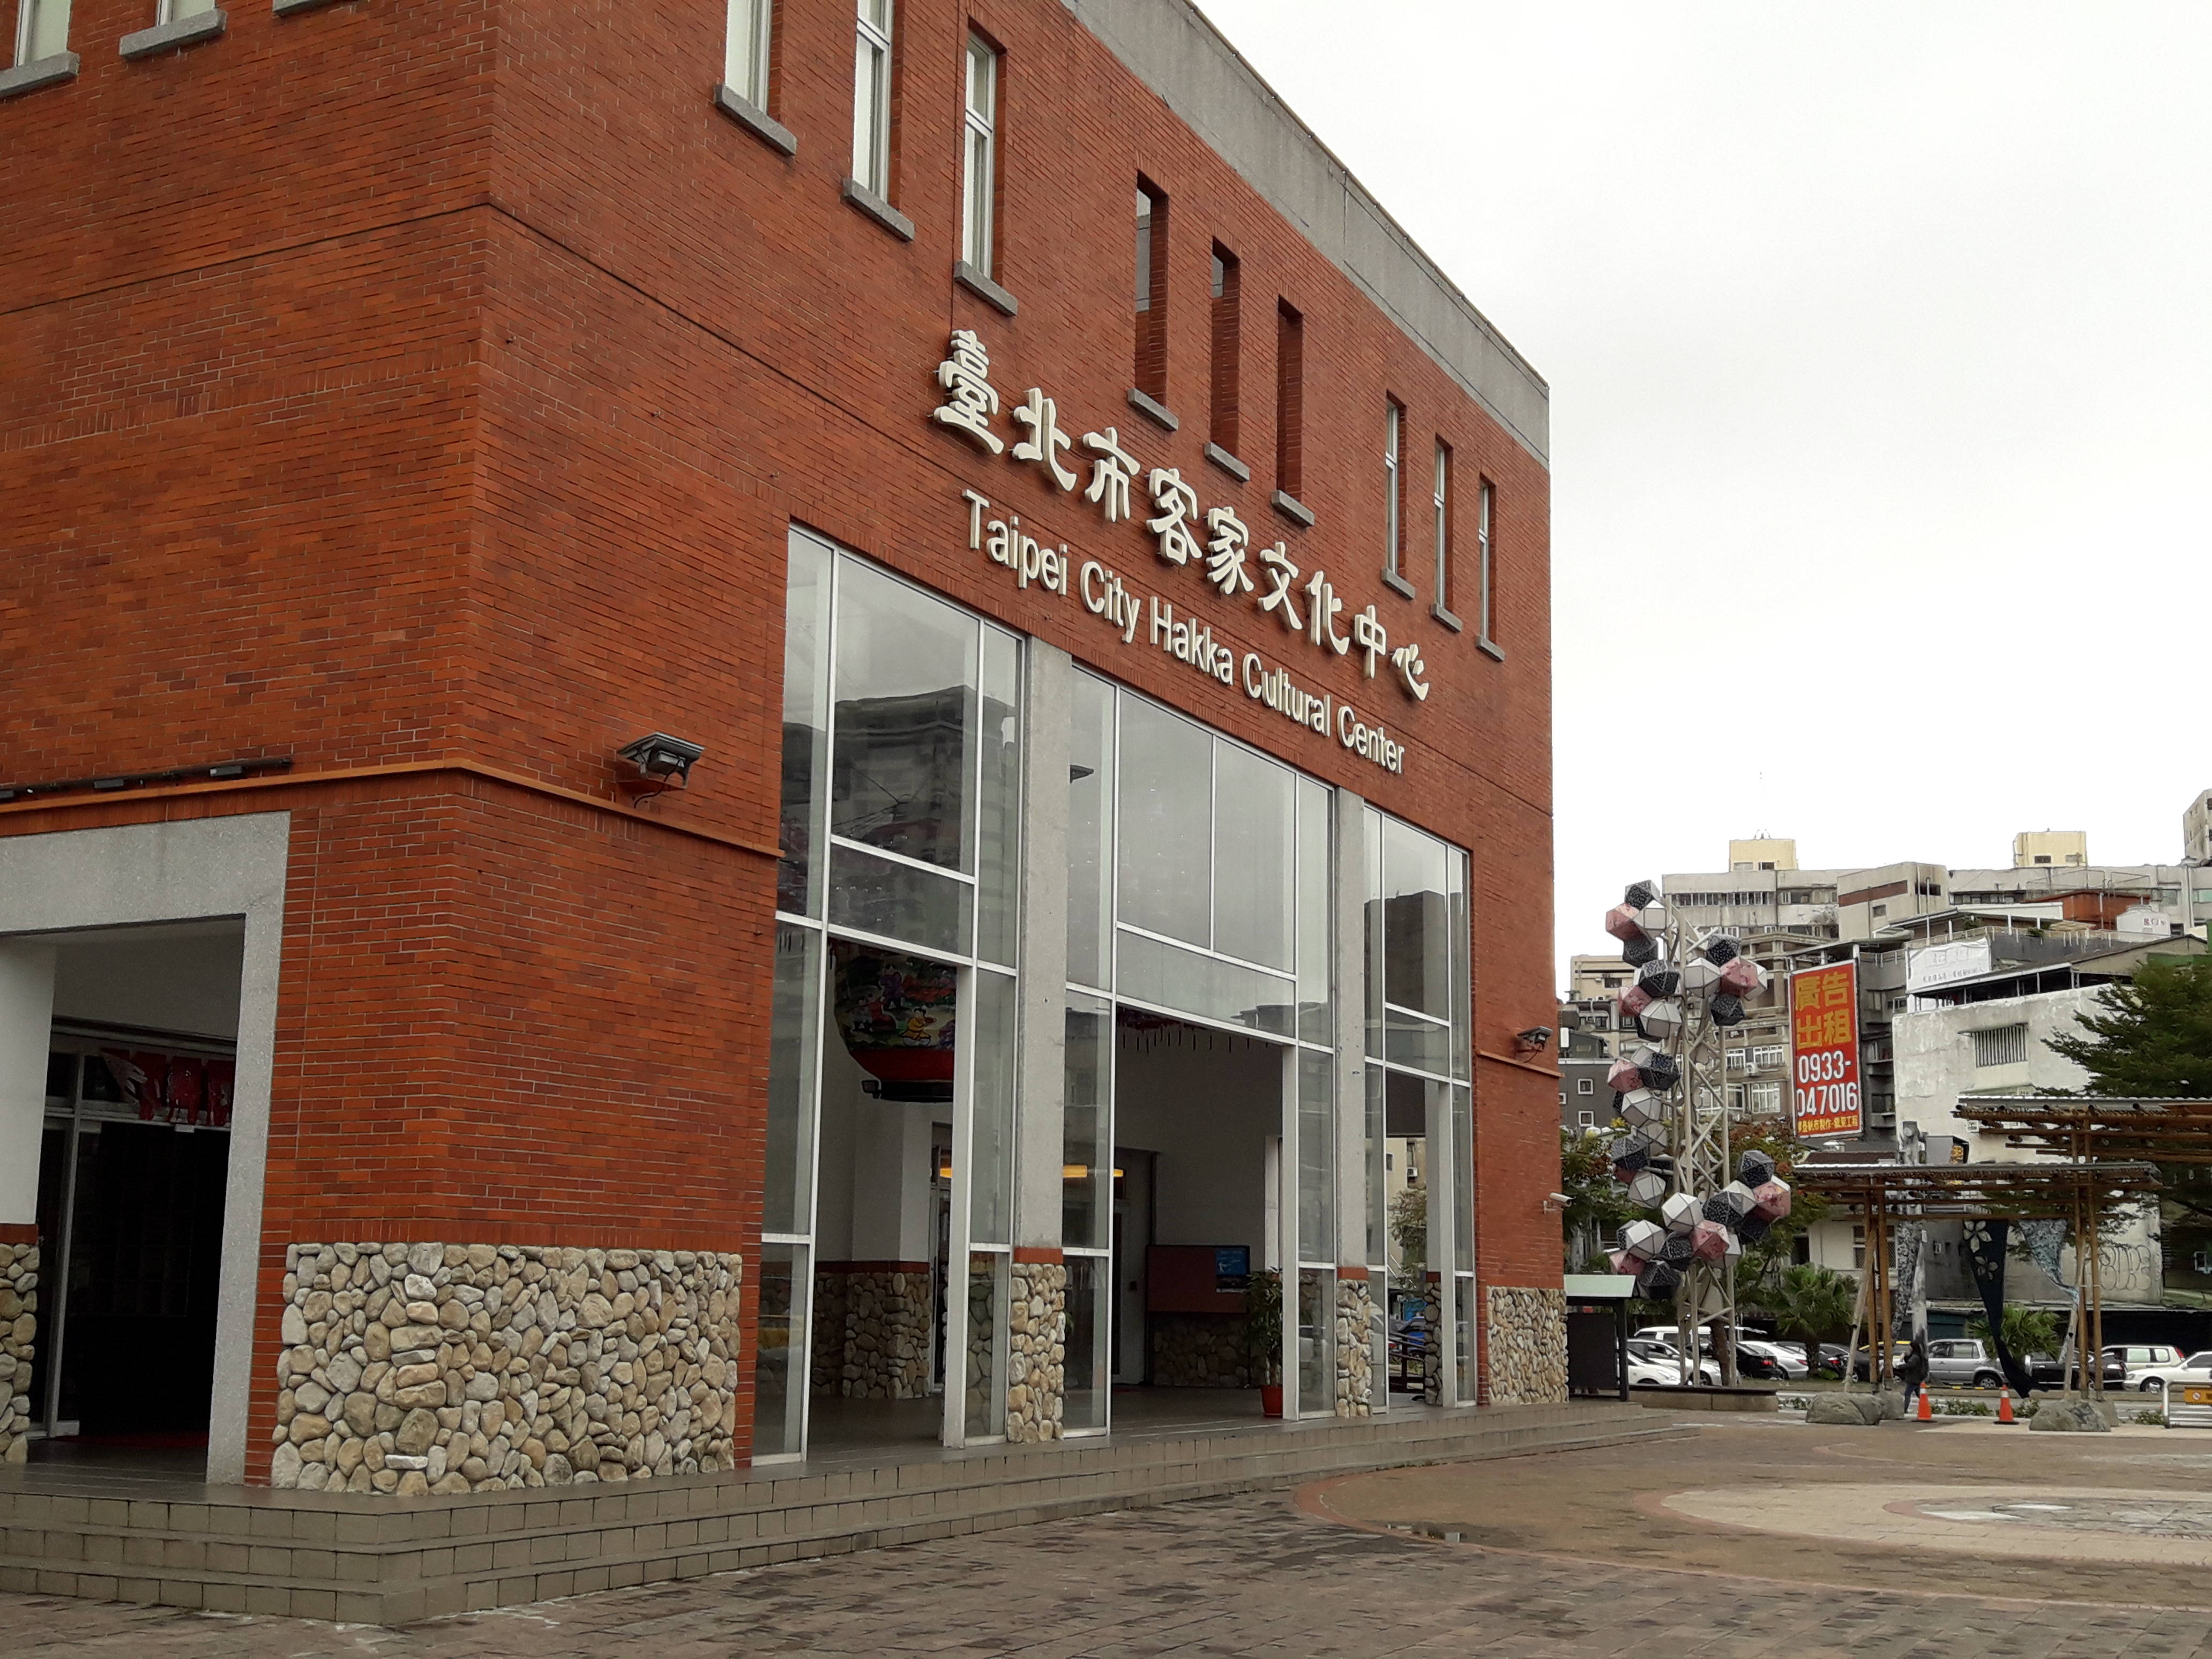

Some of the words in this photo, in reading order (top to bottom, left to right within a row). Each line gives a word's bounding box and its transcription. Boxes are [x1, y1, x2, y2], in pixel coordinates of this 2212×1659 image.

[933, 329, 1430, 701] 臺北市客家文化中心
[963, 489, 1068, 596] Taipei
[1080, 561, 1141, 644] City
[1149, 595, 1234, 686] Hakka
[1242, 652, 1331, 738] Cultural
[1337, 706, 1406, 775] Center
[1795, 971, 1850, 1012] 廣告
[1796, 1008, 1852, 1050] 出租
[1798, 1050, 1852, 1083] 0933-
[1797, 1081, 1858, 1117] 047016
